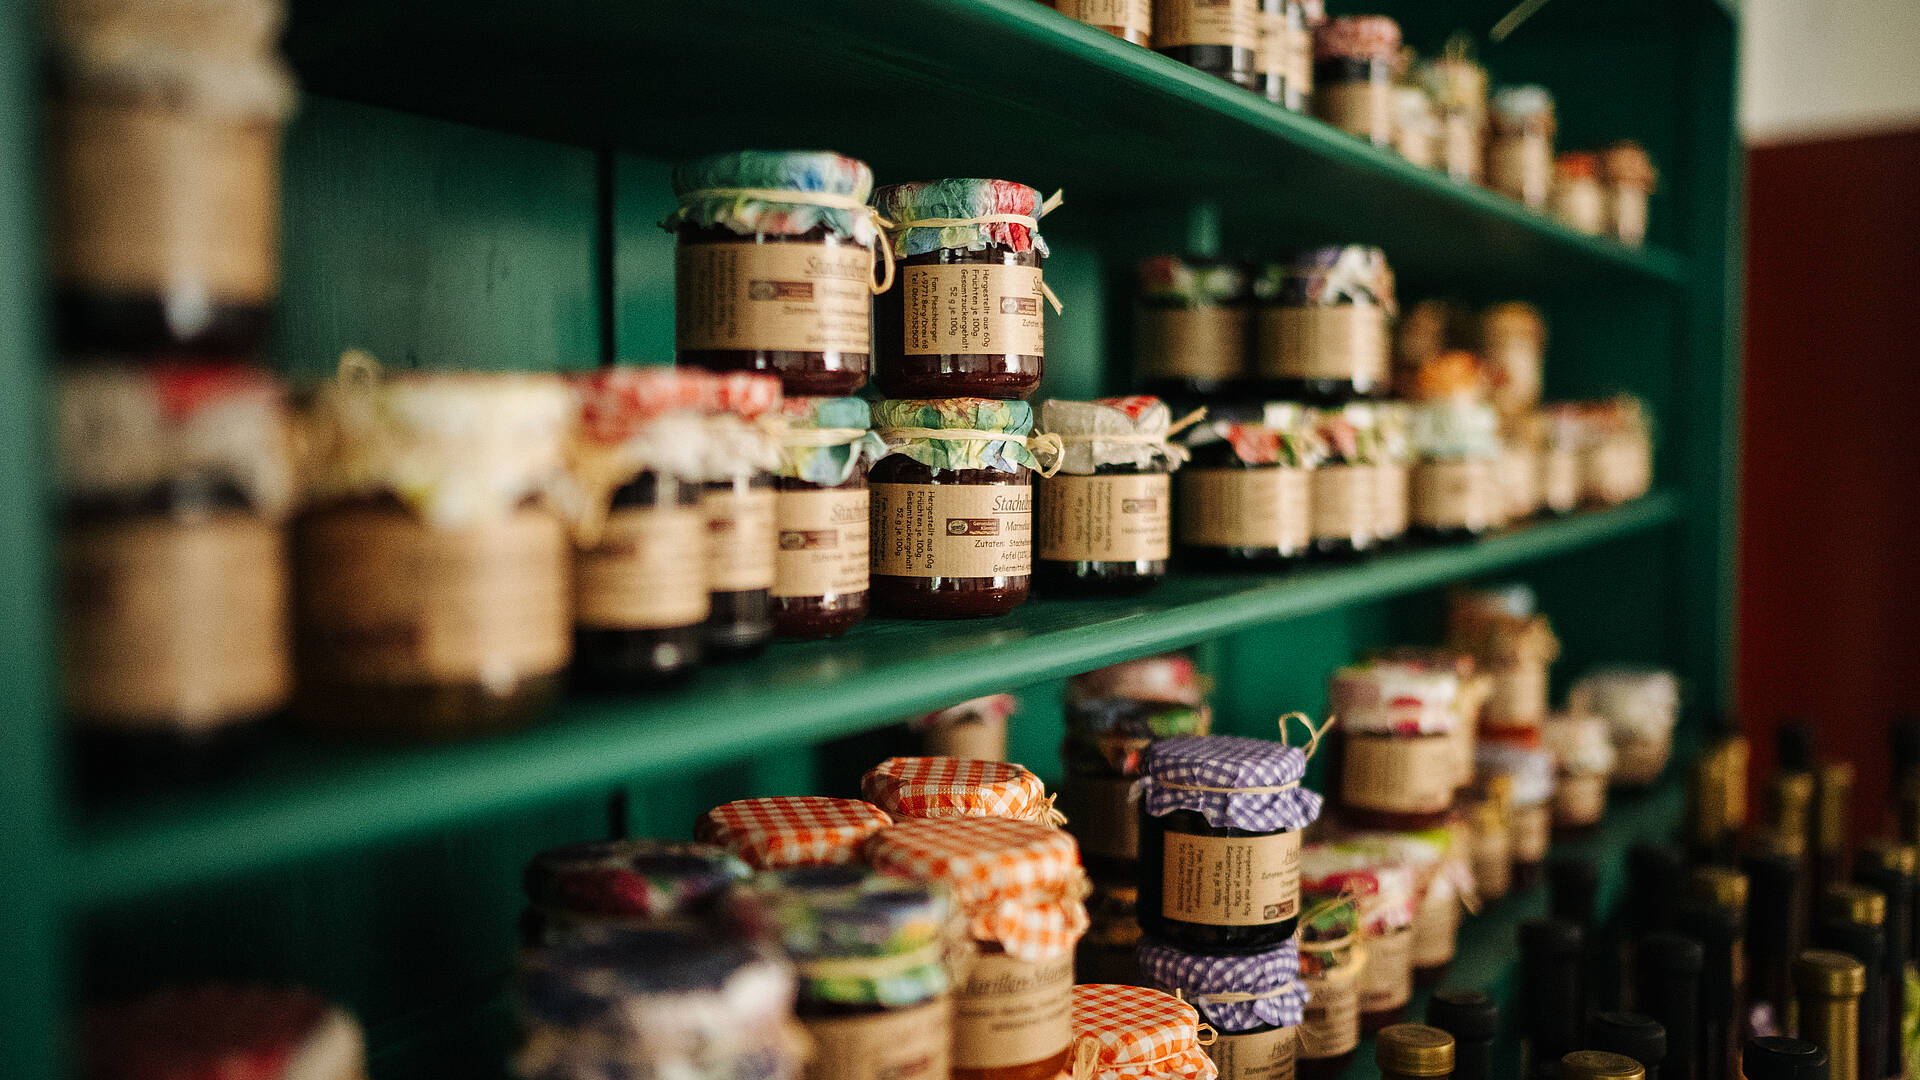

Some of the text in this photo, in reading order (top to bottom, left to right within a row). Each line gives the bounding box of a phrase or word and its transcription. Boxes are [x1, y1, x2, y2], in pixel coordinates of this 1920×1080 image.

[949, 286, 957, 298] 52
[981, 269, 991, 314] Hergestellt
[948, 306, 957, 316] je
[970, 306, 979, 316] je
[981, 331, 991, 348] 60g
[895, 507, 904, 518] 52
[916, 491, 925, 527] Früchten
[925, 491, 935, 536] Hergestellt
[894, 526, 904, 536] je
[914, 527, 924, 537] je
[924, 553, 935, 569] 60g
